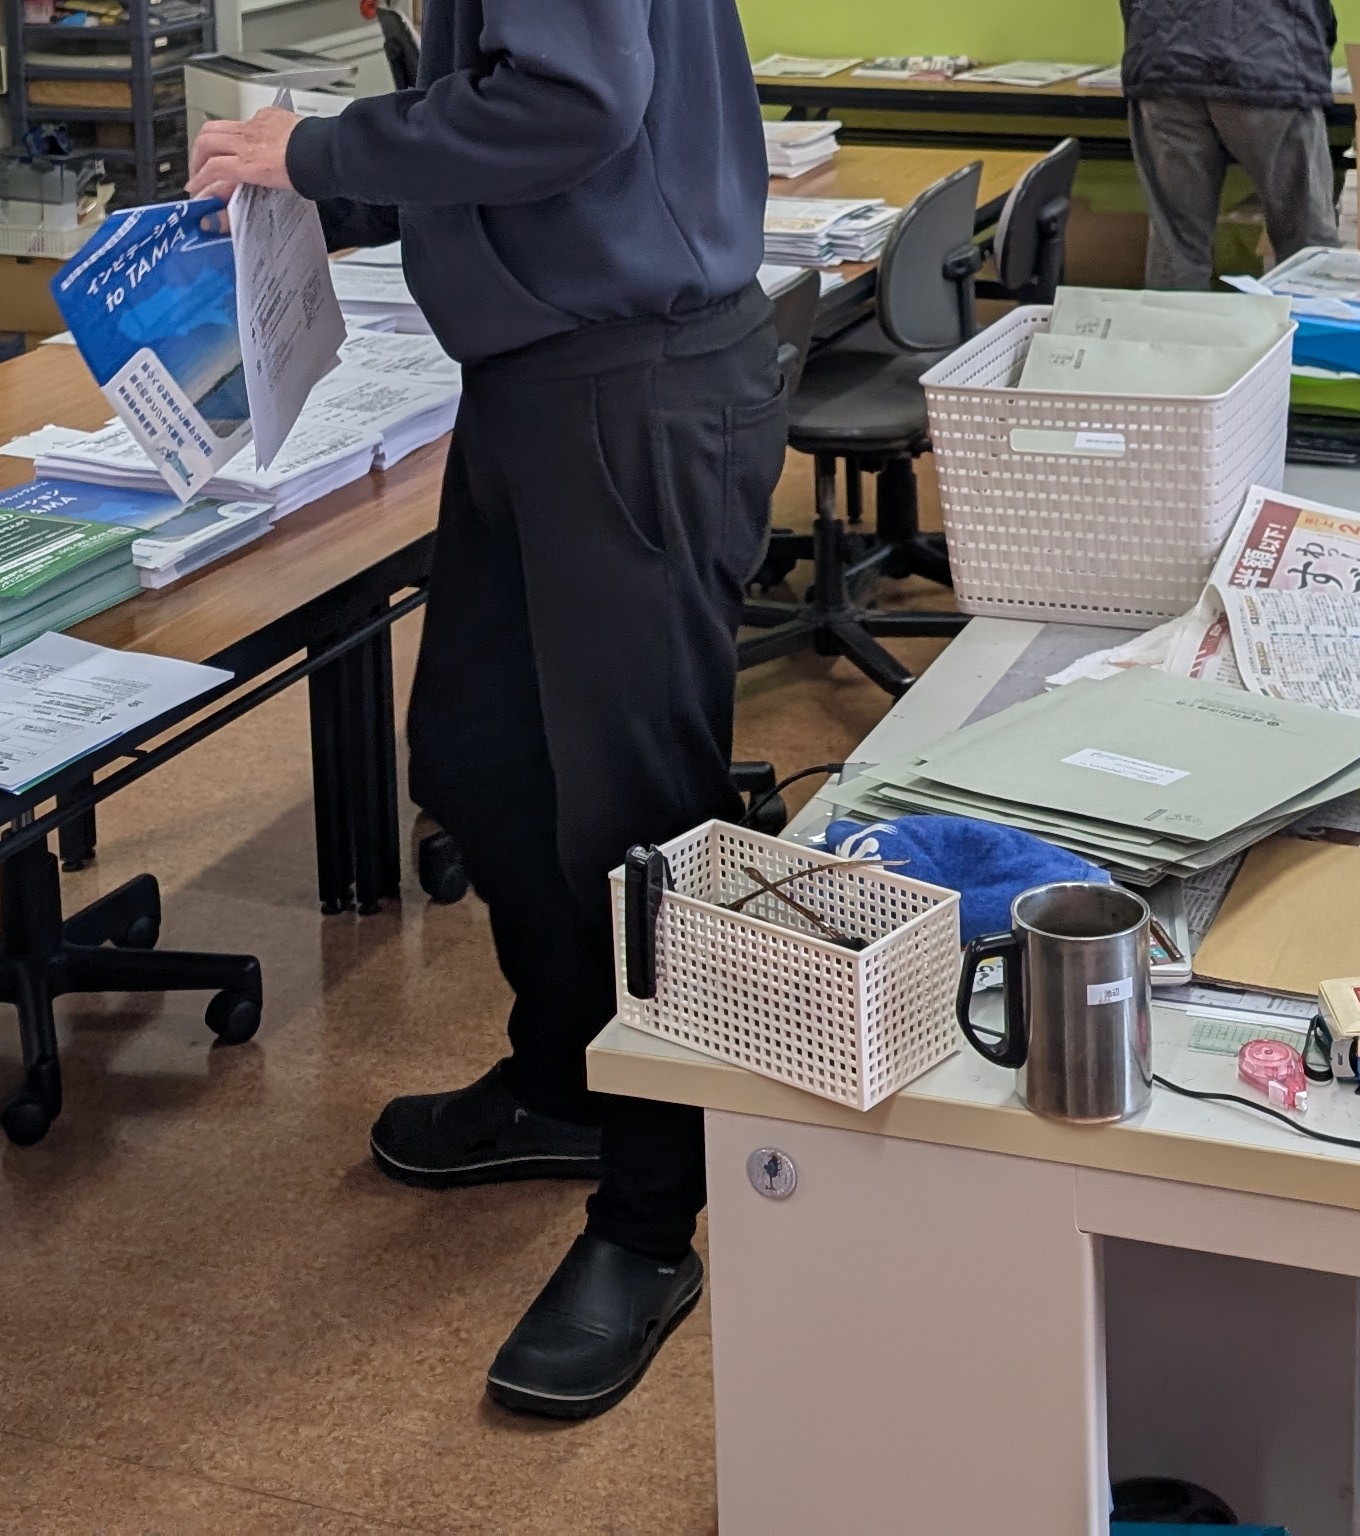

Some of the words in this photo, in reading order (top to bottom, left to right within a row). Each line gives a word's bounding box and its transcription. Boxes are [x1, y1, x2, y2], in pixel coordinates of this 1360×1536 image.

[87, 203, 190, 295] インビテーション
[105, 290, 124, 312] to
[125, 226, 186, 290] TAMA
